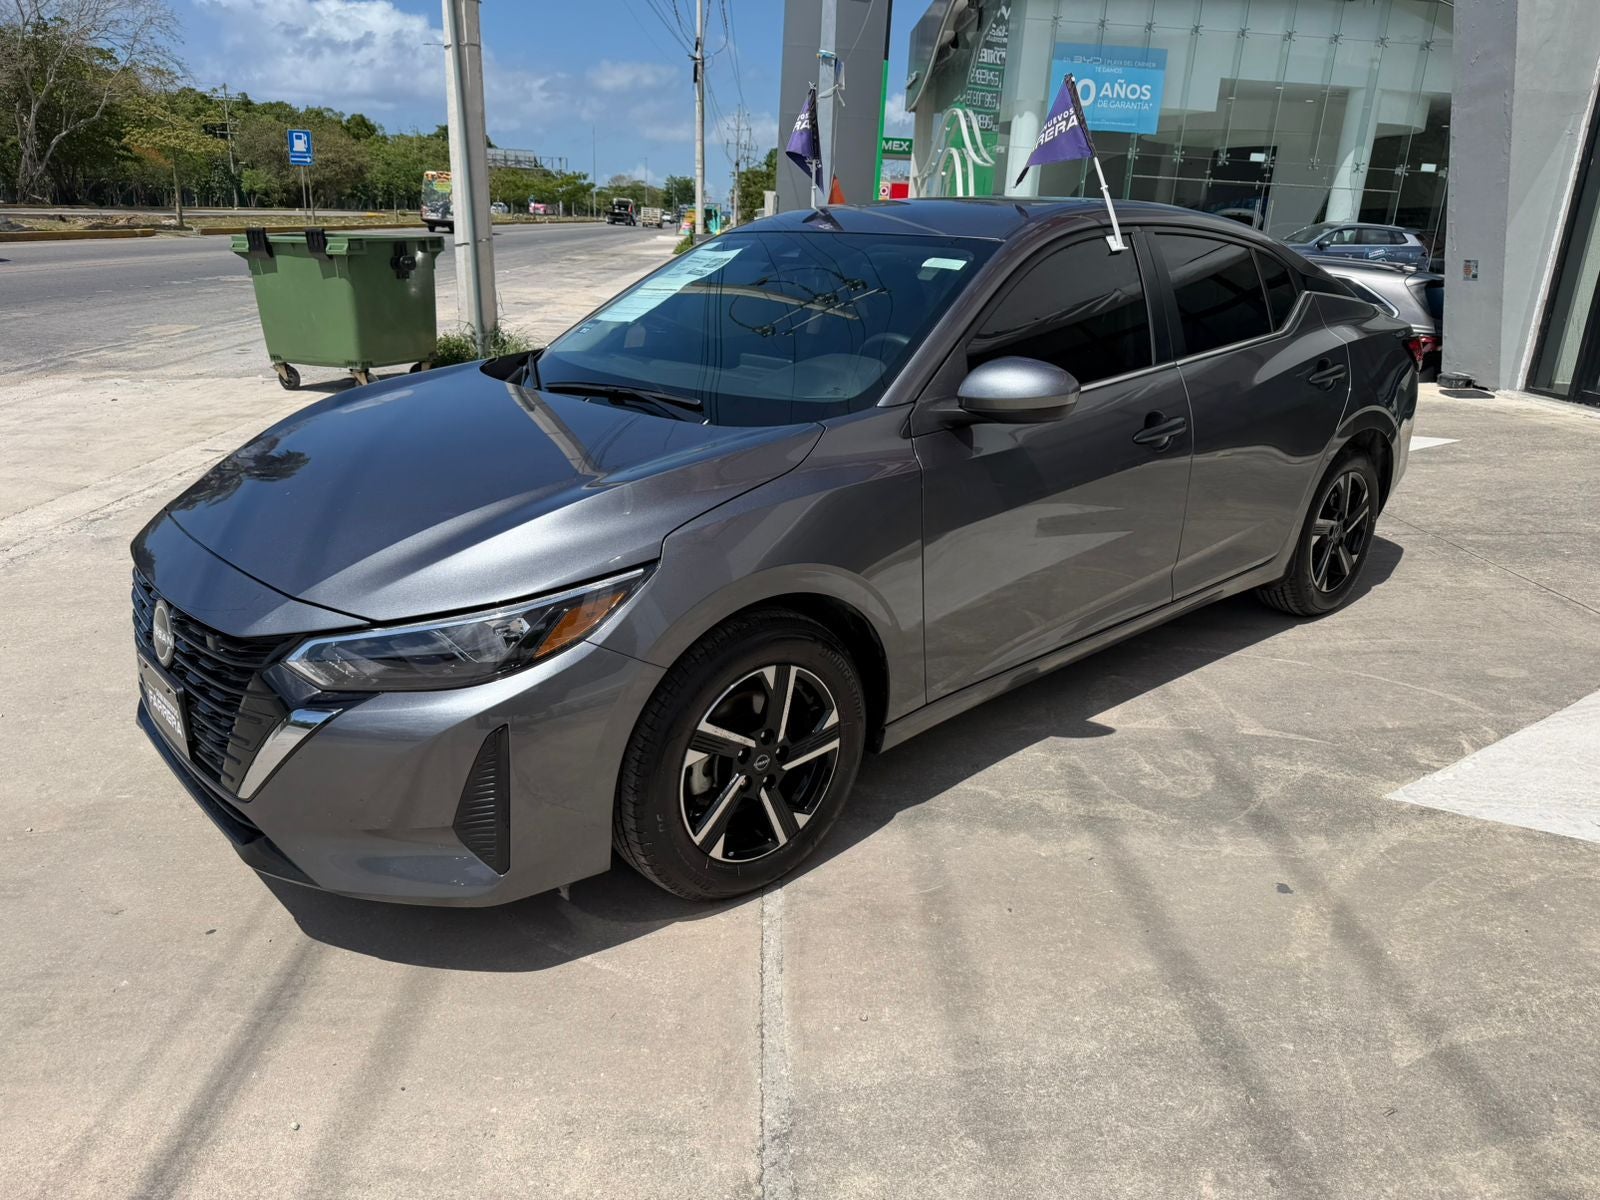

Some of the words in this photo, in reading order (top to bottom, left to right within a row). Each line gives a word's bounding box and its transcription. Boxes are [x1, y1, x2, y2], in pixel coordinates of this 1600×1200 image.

[1072, 55, 1102, 65] BYD
[1076, 78, 1097, 107] 0
[1100, 78, 1152, 100] AÑOS
[1097, 100, 1108, 108] DE
